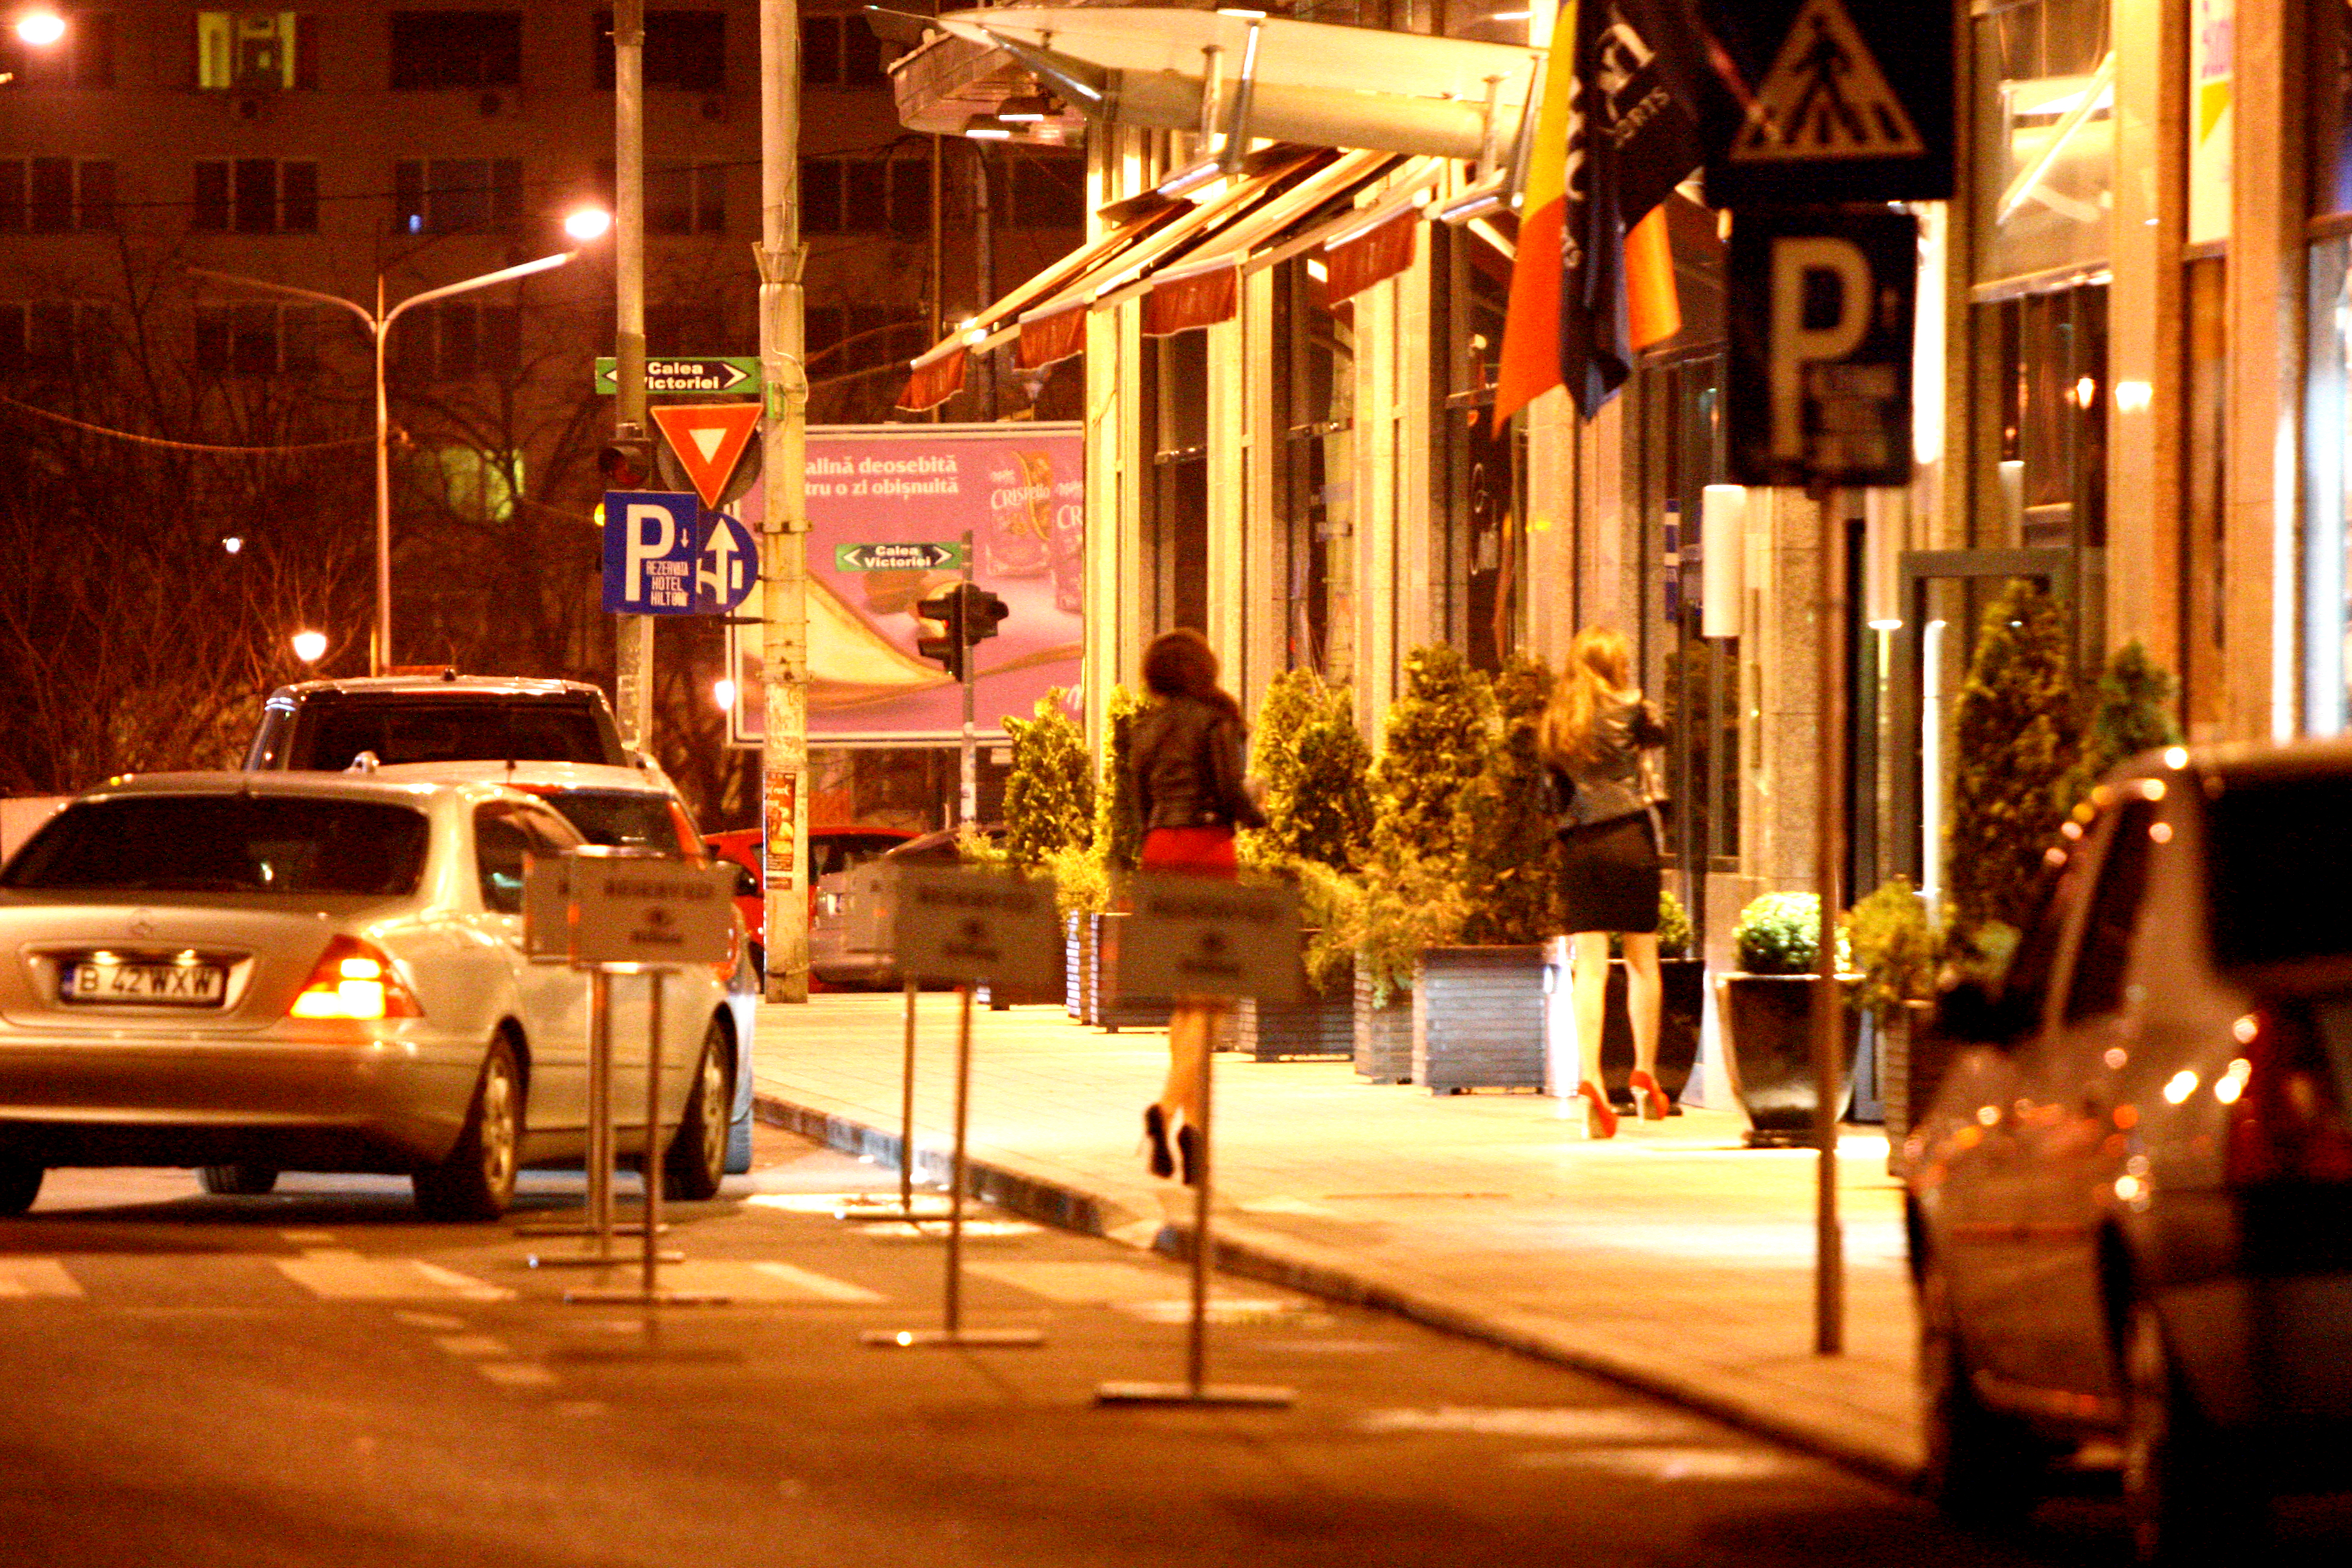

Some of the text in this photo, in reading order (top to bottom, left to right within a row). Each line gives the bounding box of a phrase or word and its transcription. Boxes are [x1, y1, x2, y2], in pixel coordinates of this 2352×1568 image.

[1771, 235, 1873, 457] P
[648, 362, 704, 374] Calea
[644, 376, 719, 389] ictoriei
[805, 454, 958, 475] alină deosebită
[804, 482, 832, 496] tru
[835, 483, 848, 496] o
[852, 478, 868, 495] zi
[625, 503, 676, 602] P
[875, 545, 920, 557] Calea
[864, 556, 932, 568] Victoriei
[652, 576, 684, 591] HOTEL
[79, 968, 99, 992] B
